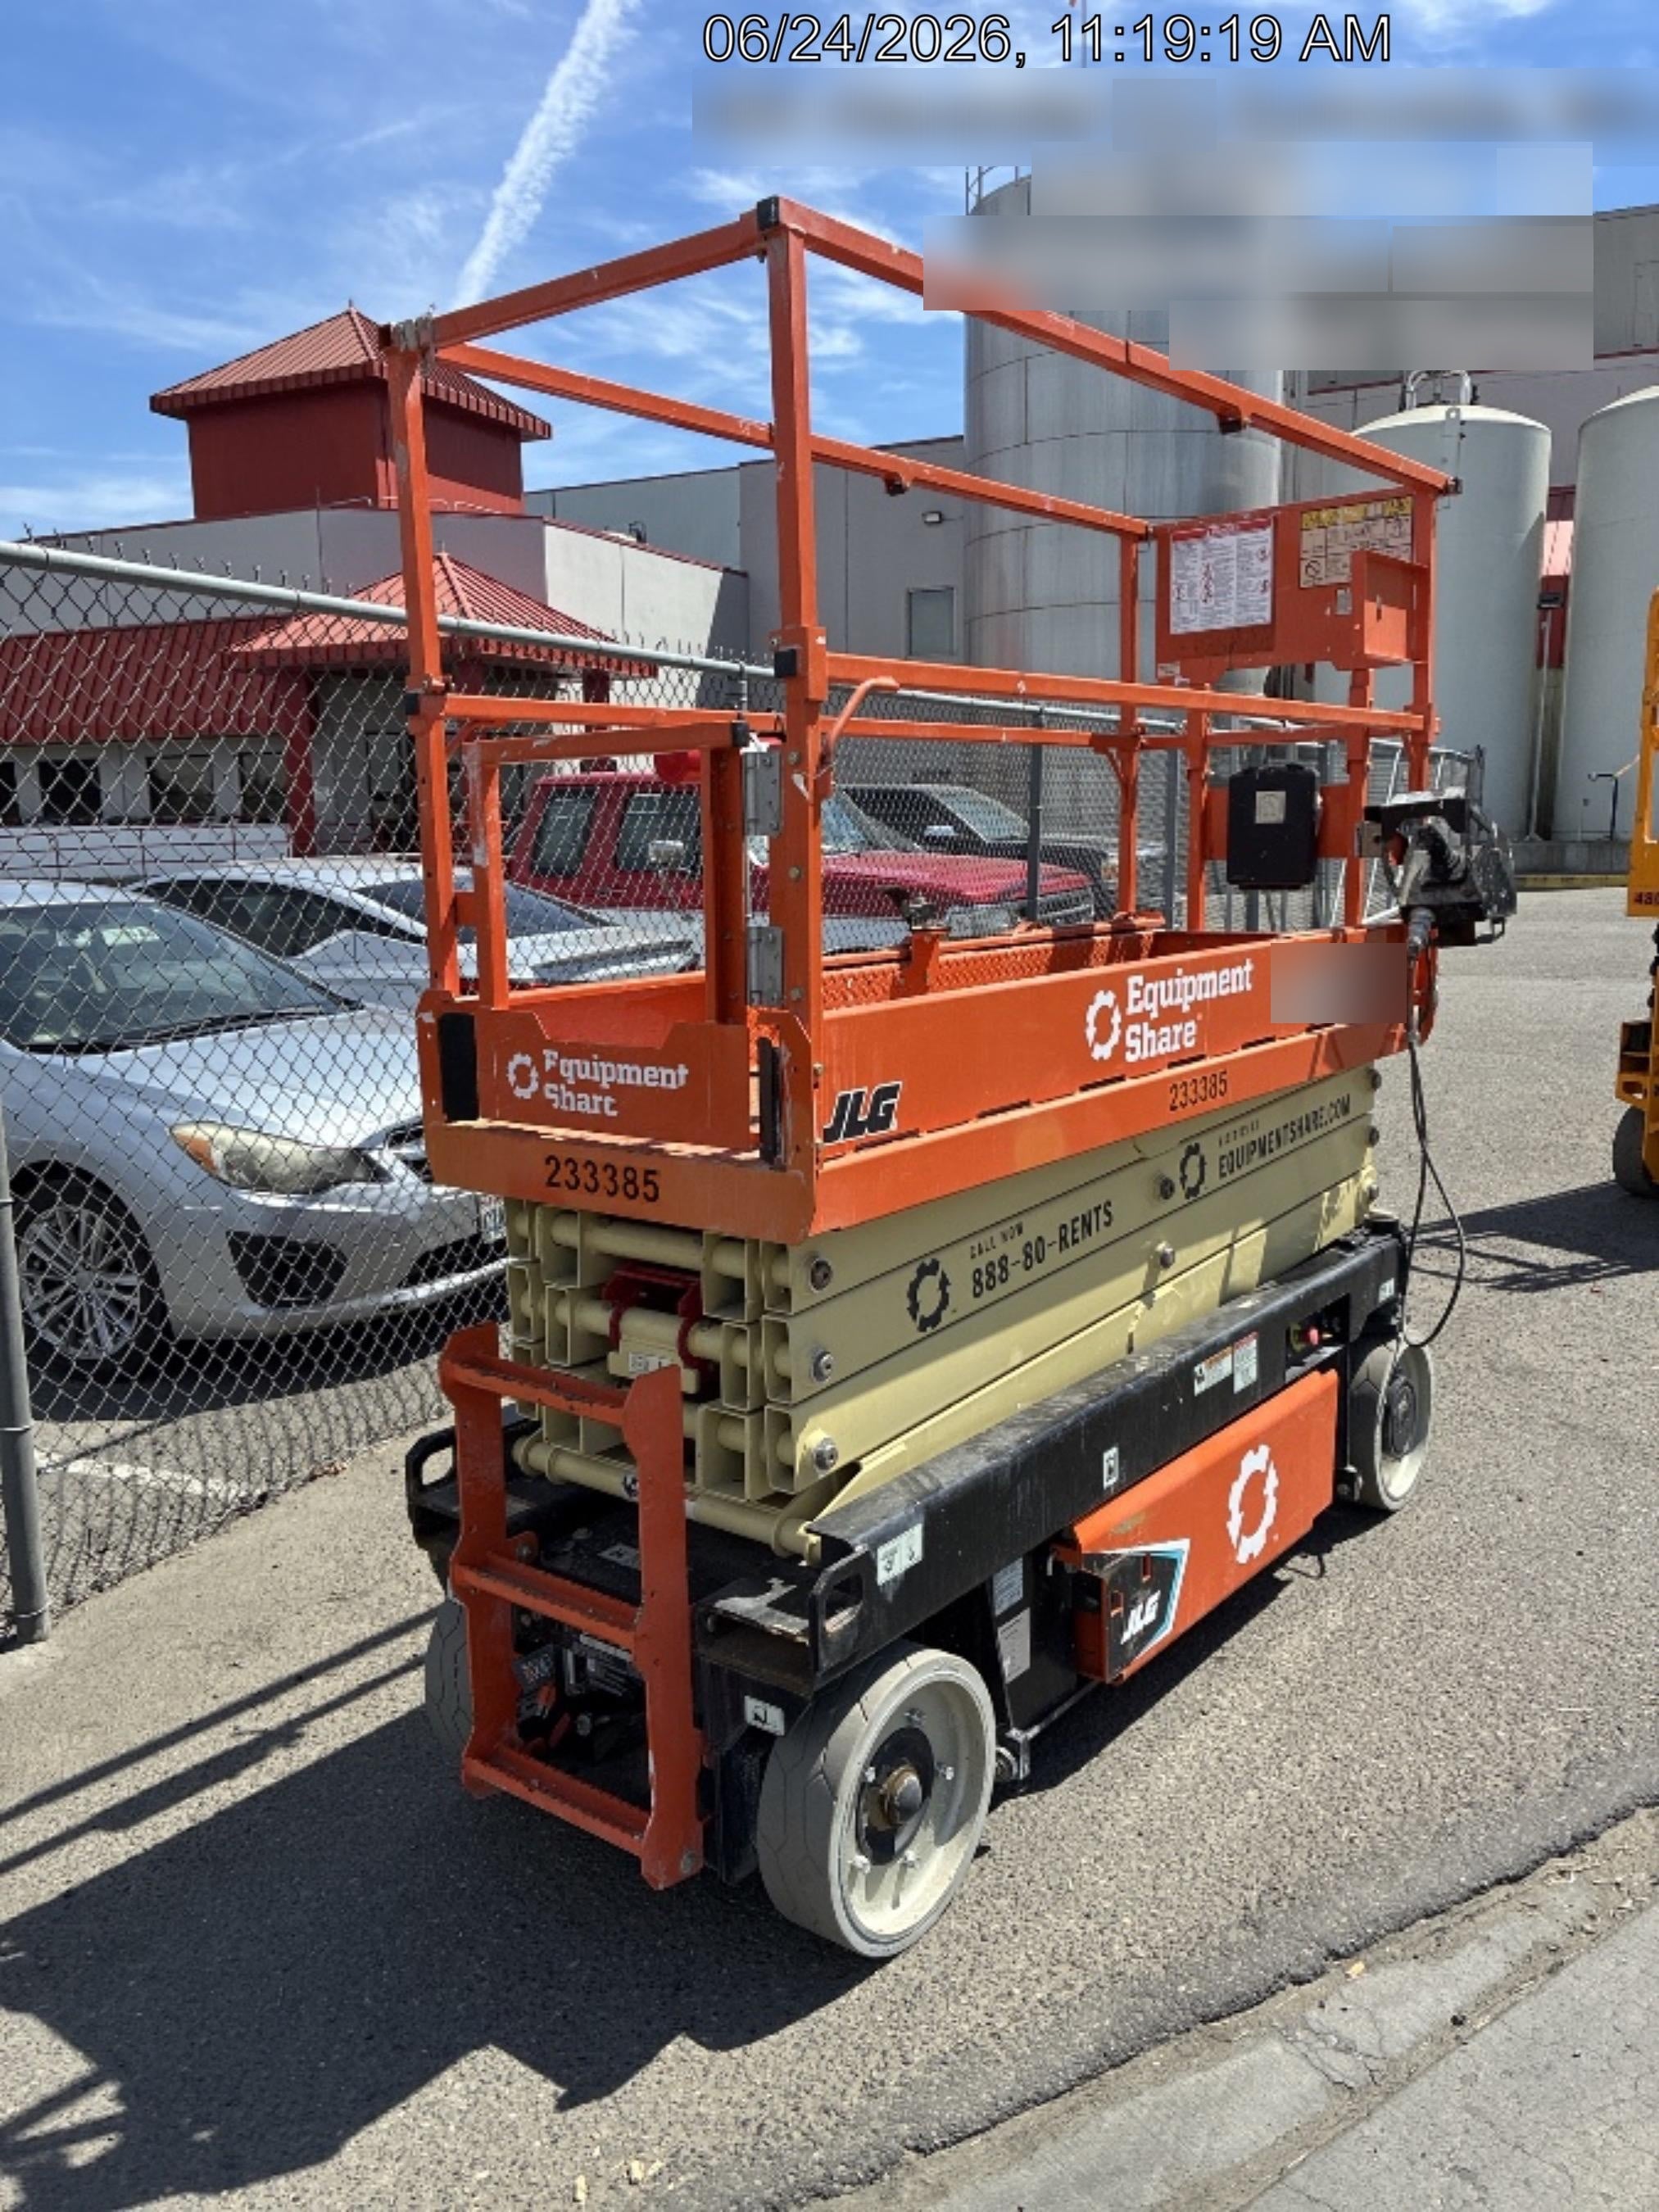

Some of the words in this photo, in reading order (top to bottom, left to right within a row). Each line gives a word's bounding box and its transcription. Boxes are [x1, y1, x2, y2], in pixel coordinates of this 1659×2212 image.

[1126, 958, 1253, 1020] Equipment
[1125, 1021, 1197, 1063] Share
[823, 1081, 902, 1145] JLG
[1169, 1070, 1228, 1111] 233385
[1219, 1093, 1350, 1178] EQUIPMENTSHARE.COM
[545, 1155, 660, 1203] 233385
[972, 1199, 1113, 1299] 888-80-RENTS
[1120, 1589, 1161, 1645] JLG
